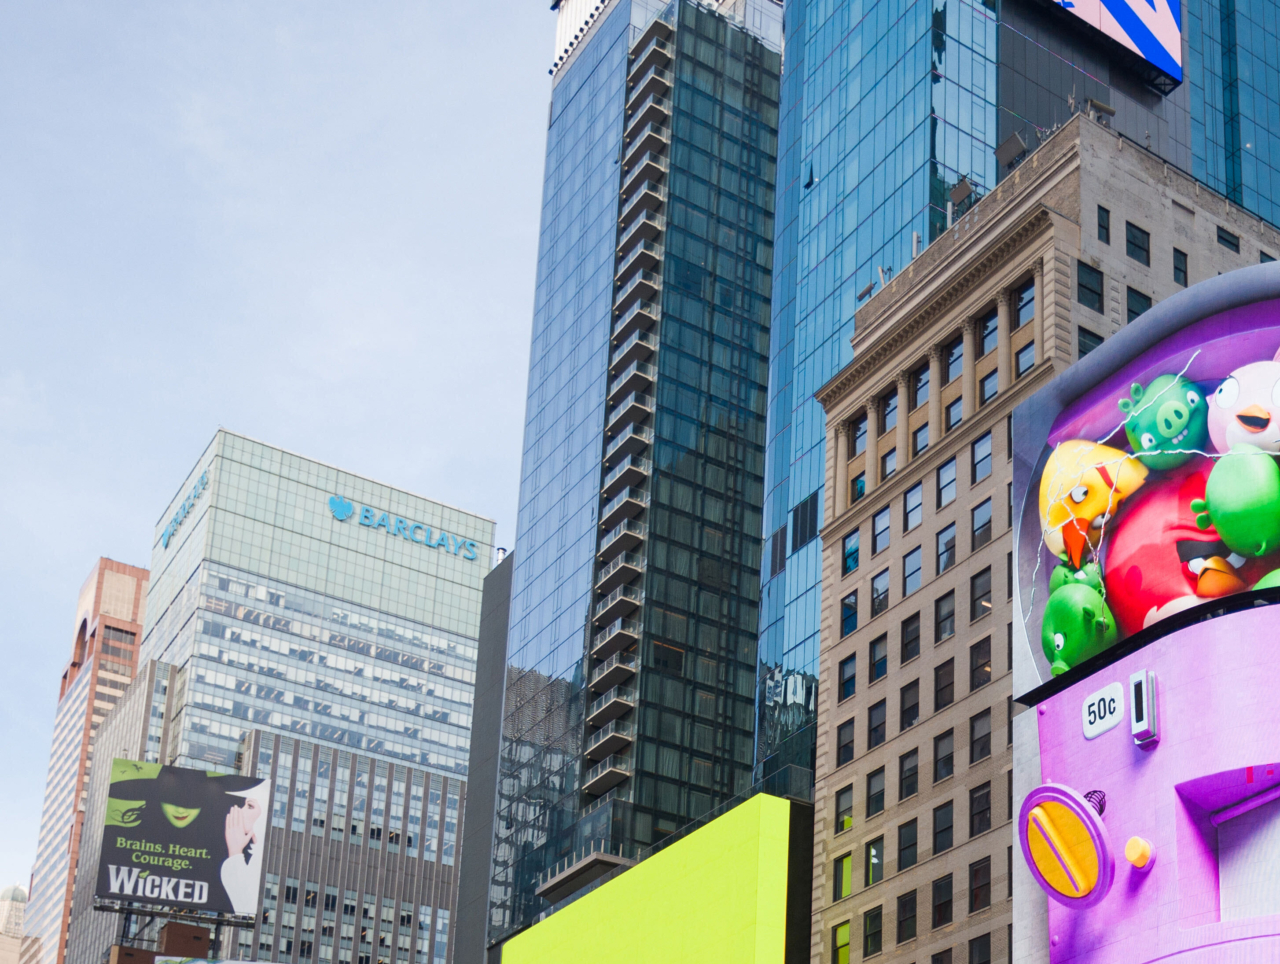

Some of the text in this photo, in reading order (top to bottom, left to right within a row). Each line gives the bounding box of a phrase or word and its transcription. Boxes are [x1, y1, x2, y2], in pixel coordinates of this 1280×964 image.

[359, 506, 477, 560] BARCLAYS
[116, 837, 211, 859] Brains. Heart.
[132, 852, 192, 871] Courage.
